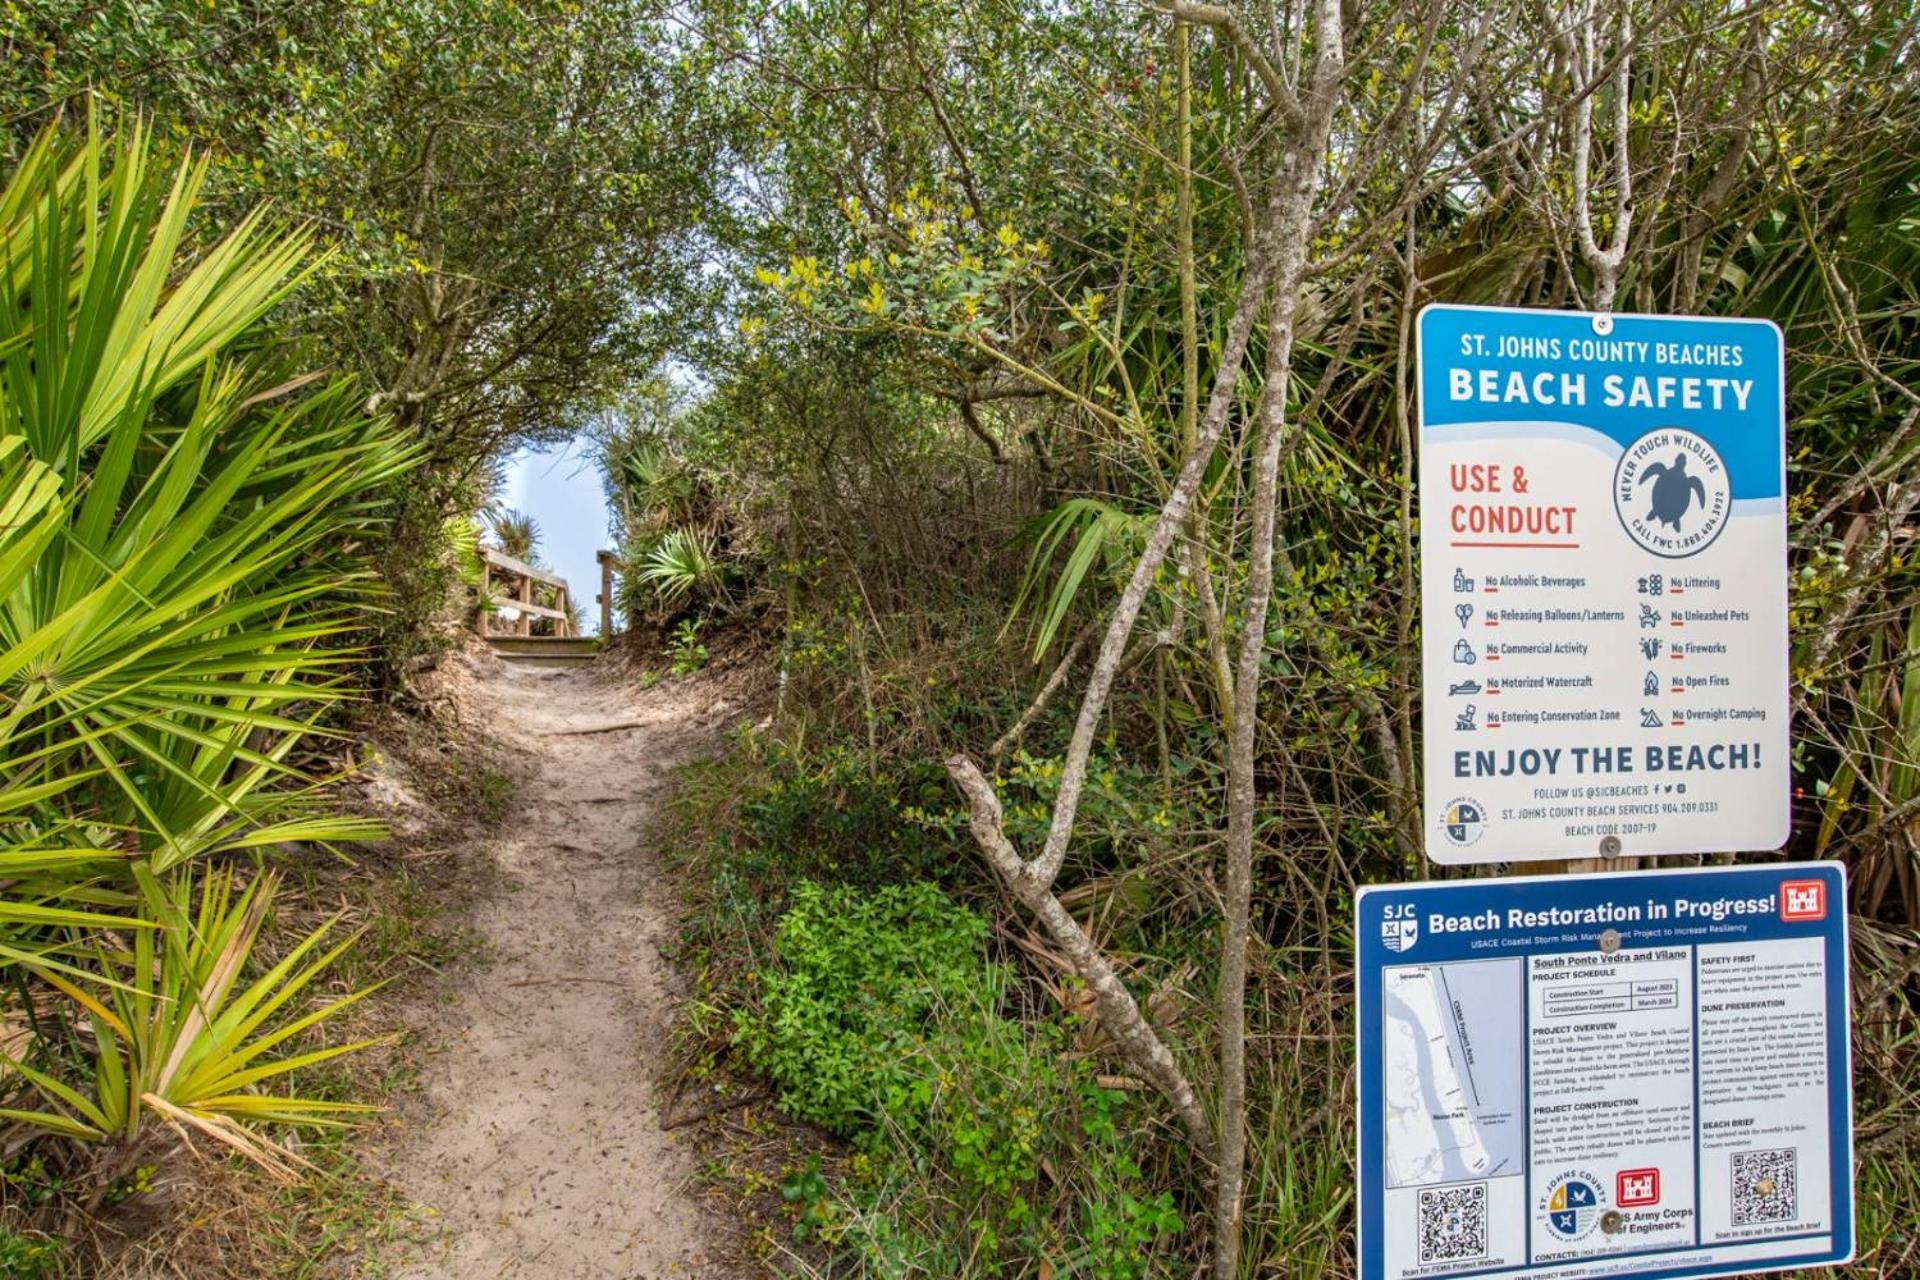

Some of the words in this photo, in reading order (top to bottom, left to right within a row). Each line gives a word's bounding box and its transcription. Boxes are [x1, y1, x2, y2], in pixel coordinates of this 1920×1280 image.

[1461, 334, 1489, 357] ST.
[1497, 336, 1562, 360] JOHNS
[1569, 339, 1649, 363] COUNTY
[1656, 344, 1743, 367] BEACHES
[1450, 368, 1587, 406] BEACH
[1603, 374, 1753, 411] SAFETY
[1620, 460, 1638, 502] NEVER
[1634, 434, 1670, 460] TOUCH
[1673, 434, 1719, 474] WILDLIFE
[1450, 464, 1501, 492] USE
[1512, 466, 1528, 493] &
[1451, 505, 1577, 535] CONDUCT
[1632, 519, 1651, 541] CALL
[1652, 535, 1673, 549] FWC
[1486, 576, 1498, 586] No
[1500, 575, 1539, 587] Alcoholic
[1541, 576, 1586, 589] Beverages
[1670, 577, 1682, 587] No
[1684, 576, 1720, 590] Littering
[1486, 610, 1499, 620] No
[1501, 610, 1543, 623] Releasing
[1545, 609, 1625, 622] Balloons/Lanterns
[1671, 611, 1683, 620] No
[1685, 610, 1728, 621] Unleashed
[1731, 610, 1749, 621] Pets
[1486, 644, 1499, 654] No
[1501, 643, 1552, 654] Commercial
[1554, 642, 1588, 656] Activity
[1671, 643, 1683, 653] No
[1685, 642, 1727, 653] Fireworks
[1487, 678, 1499, 688] No
[1501, 677, 1544, 688] Motorized
[1546, 675, 1592, 687] Watercraft
[1672, 676, 1684, 686] No
[1686, 676, 1707, 688] Open
[1709, 675, 1730, 686] Fires
[1487, 712, 1499, 722] No
[1501, 711, 1539, 723] Entering
[1541, 709, 1598, 722] Conservation
[1600, 710, 1620, 720] Zone
[1672, 710, 1684, 720] No
[1686, 708, 1727, 721] Overnight
[1729, 707, 1766, 721] Camping
[1454, 749, 1562, 778] ENJOY
[1571, 747, 1633, 774] THE
[1646, 743, 1762, 772] BEACH!
[1534, 788, 1569, 799] FOLLOW
[1571, 788, 1583, 798] US
[1586, 785, 1649, 799] @SJCBEACHES
[1502, 810, 1516, 820] ST.
[1518, 808, 1547, 820] JOHNS
[1549, 806, 1584, 818] COUNTY
[1587, 805, 1615, 817] BEACH
[1618, 803, 1659, 815] SERVICES
[1661, 801, 1719, 814] 904.209.0331
[1565, 824, 1594, 836] BEACH
[1596, 823, 1619, 835] CODE
[1622, 822, 1657, 834] 2007-19
[1384, 904, 1416, 919] SJC
[1429, 908, 1500, 934] Beach
[1508, 901, 1641, 928] Restoration
[1647, 900, 1667, 919] in
[1675, 894, 1776, 920] Progress!
[1471, 939, 1499, 949] USACE
[1501, 936, 1531, 947] Coastal
[1534, 935, 1559, 945] Storm
[1561, 933, 1578, 943] Risk
[1634, 929, 1662, 940] Project
[1664, 928, 1672, 937] to
[1674, 926, 1707, 936] Increase
[1709, 923, 1747, 934] Resiliency
[1534, 959, 1565, 969] South
[1568, 956, 1598, 967] Ponte
[1600, 953, 1630, 963] Vedra
[1633, 951, 1651, 961] and
[1655, 949, 1687, 960] Vilano
[1701, 957, 1731, 965] SAFETY
[1733, 955, 1755, 963] FIRST
[1533, 971, 1570, 981] PROJECT
[1572, 968, 1616, 979] SCHEDULE
[1549, 989, 1588, 999] Construction
[1589, 988, 1603, 996] Start
[1637, 984, 1658, 993] August
[1549, 1004, 1588, 1014] Construction
[1589, 1001, 1625, 1012] Completion
[1637, 998, 1657, 1006] March
[1701, 1004, 1723, 1012] DUNE
[1725, 1000, 1785, 1010] PRESERVATION
[1459, 1022, 1470, 1047] Project
[1533, 1025, 1571, 1035] PROJECT
[1573, 1022, 1617, 1032] OVERVIEW
[1534, 1104, 1572, 1114] PROJECT
[1574, 1098, 1638, 1110] CONSTRUCTION
[1703, 1121, 1729, 1130] BEACH
[1732, 1118, 1754, 1127] BRIEF
[1547, 1170, 1576, 1192] JOHNS
[1579, 1171, 1606, 1203] COUNTY
[1634, 1211, 1660, 1221] Army
[1663, 1208, 1693, 1219] Corps
[1402, 1269, 1418, 1277] Scan
[1453, 1262, 1477, 1271] Project
[1478, 1258, 1505, 1267] Website
